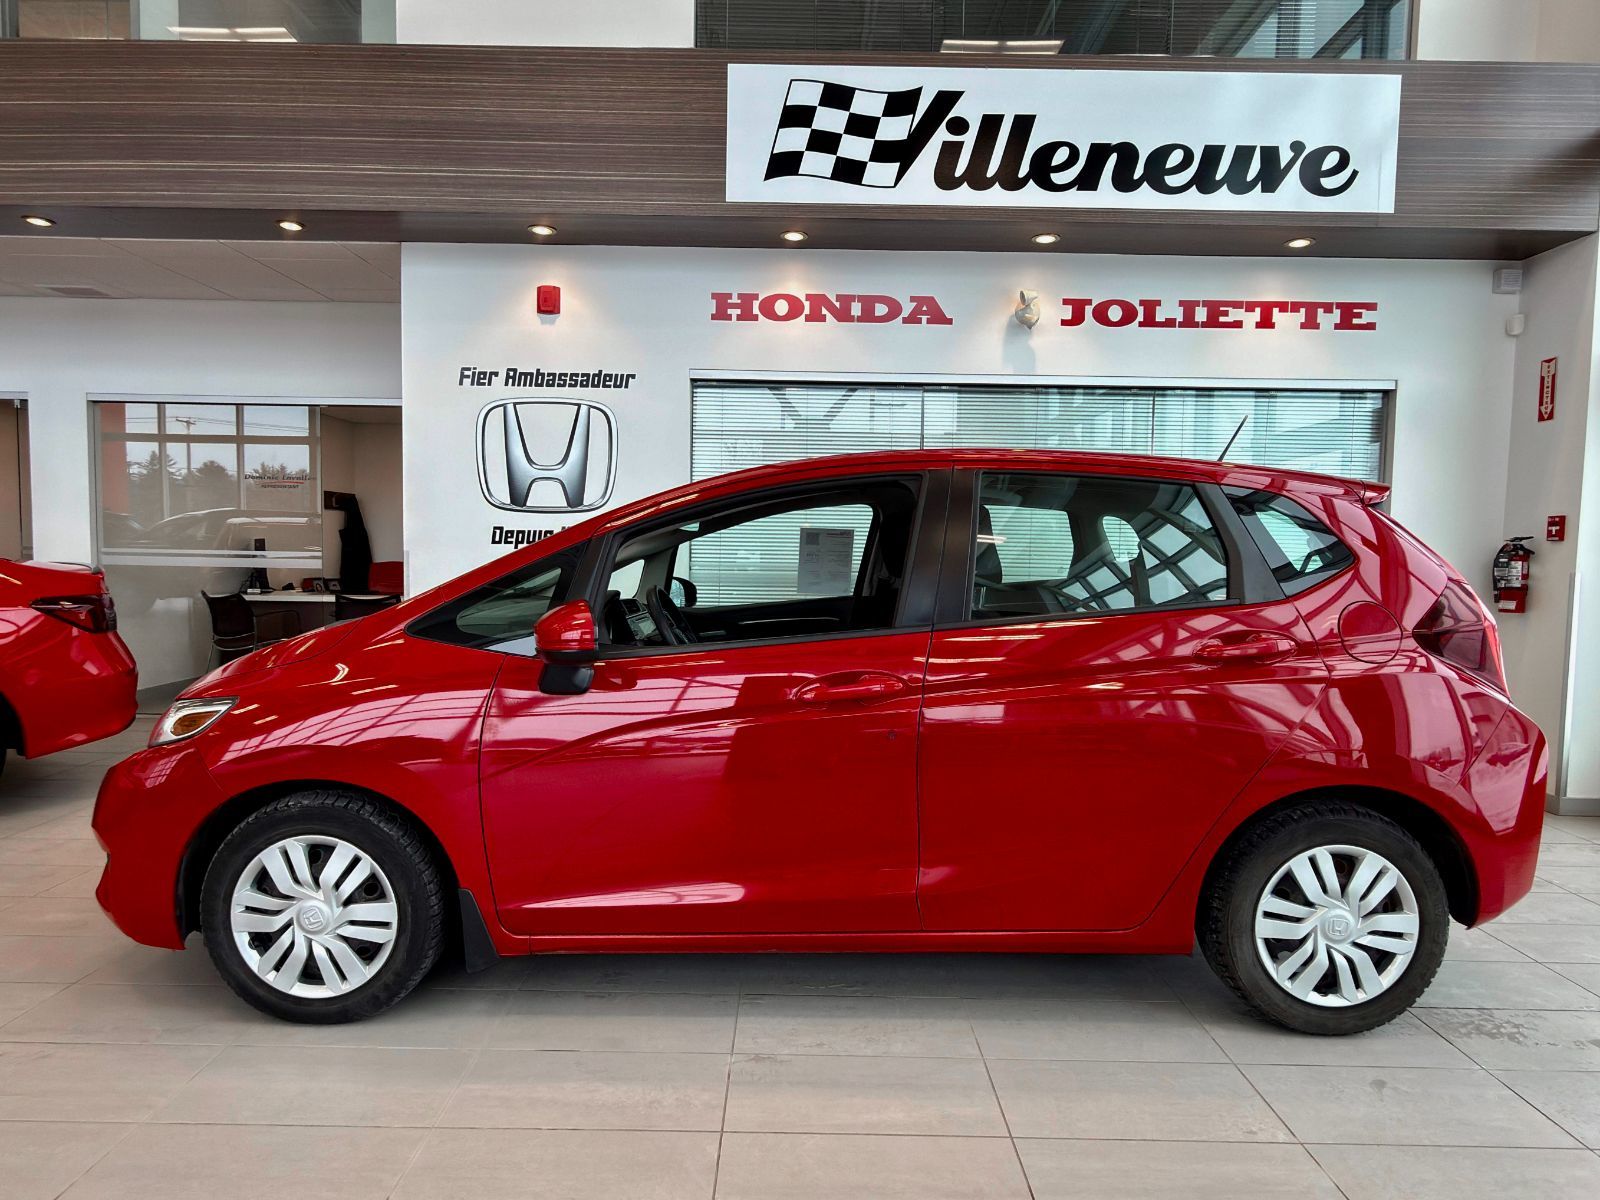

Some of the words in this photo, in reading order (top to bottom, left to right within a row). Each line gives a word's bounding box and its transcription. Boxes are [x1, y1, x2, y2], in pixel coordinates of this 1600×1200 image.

[893, 89, 1360, 198] Villeneuve
[710, 292, 954, 326] HONDA
[1060, 298, 1378, 331] JOLIETTE
[459, 366, 499, 387] Fier
[504, 367, 636, 389] Ambassadeur
